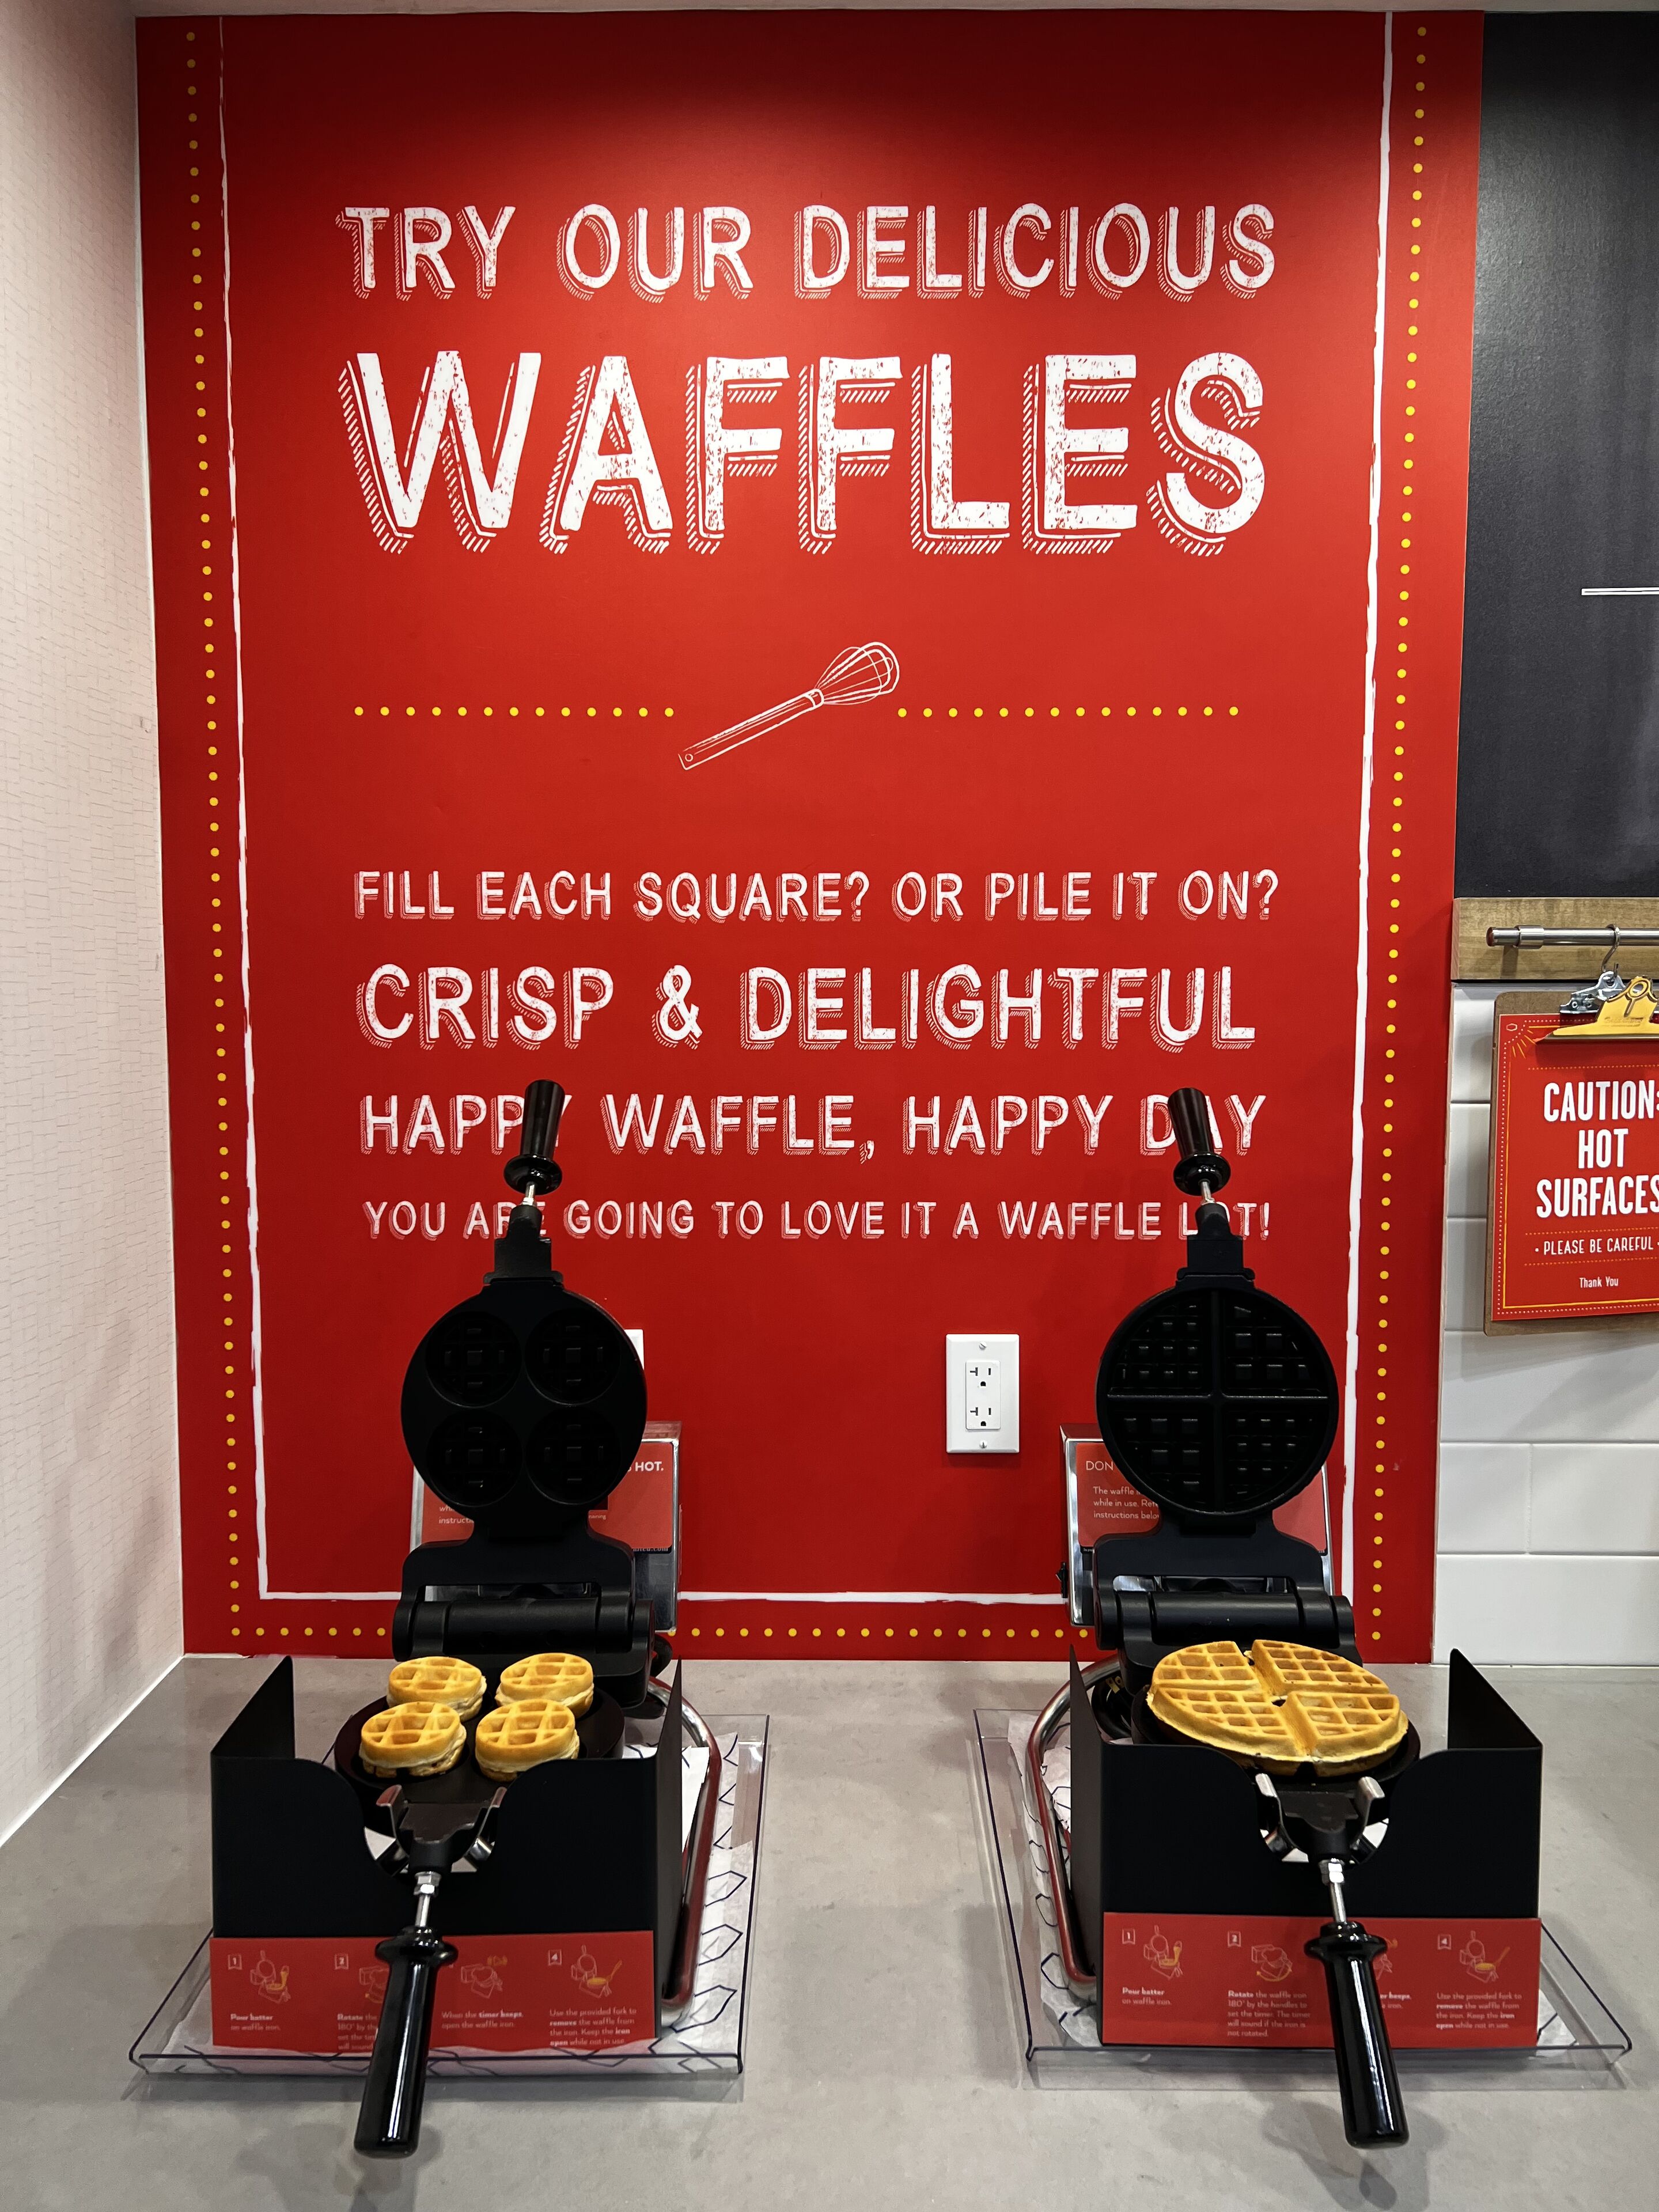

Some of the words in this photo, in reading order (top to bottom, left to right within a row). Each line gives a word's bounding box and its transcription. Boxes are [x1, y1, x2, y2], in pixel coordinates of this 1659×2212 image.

[336, 205, 516, 301] TRY
[556, 203, 753, 304] OUR
[794, 203, 1275, 302] DELICIOUS
[337, 350, 1266, 557] WAFFLES
[354, 870, 454, 920] FILL
[476, 870, 611, 921] EACH
[633, 870, 870, 923] SQUARE?
[892, 872, 964, 922] OR
[985, 871, 1092, 921] PILE
[1112, 872, 1158, 921] IT
[1177, 869, 1279, 921] ON?
[356, 963, 613, 1051] CRISP
[652, 964, 703, 1050] &
[740, 963, 1256, 1053] DELIGHTFUL
[600, 1093, 874, 1164] WAFFLE,
[903, 1094, 1113, 1156] HAPPY
[1578, 1128, 1629, 1169] HOT
[1536, 1174, 1659, 1218] SURFACES
[364, 1200, 446, 1240] YOU
[563, 1199, 694, 1240] GOING
[711, 1200, 763, 1240] TO
[781, 1200, 885, 1239] LOVE
[901, 1201, 937, 1238] IT
[952, 1202, 979, 1239] A
[998, 1201, 1161, 1240] WAFFLE
[1178, 1202, 1270, 1240] LT!
[1543, 1238, 1585, 1256] PLEASE
[1589, 1238, 1603, 1253] BE
[1606, 1236, 1654, 1253] CAREFUL
[1578, 1276, 1603, 1289] Thank
[1605, 1275, 1619, 1287] You
[635, 1461, 664, 1472] HOT.
[1085, 1460, 1114, 1471] DON
[1093, 1486, 1108, 1495] The
[1109, 1486, 1134, 1495] waffle
[1093, 1498, 1113, 1506] while
[1115, 1498, 1122, 1506] in
[1093, 1510, 1139, 1519] instructions
[1126, 1931, 1131, 1940] 1
